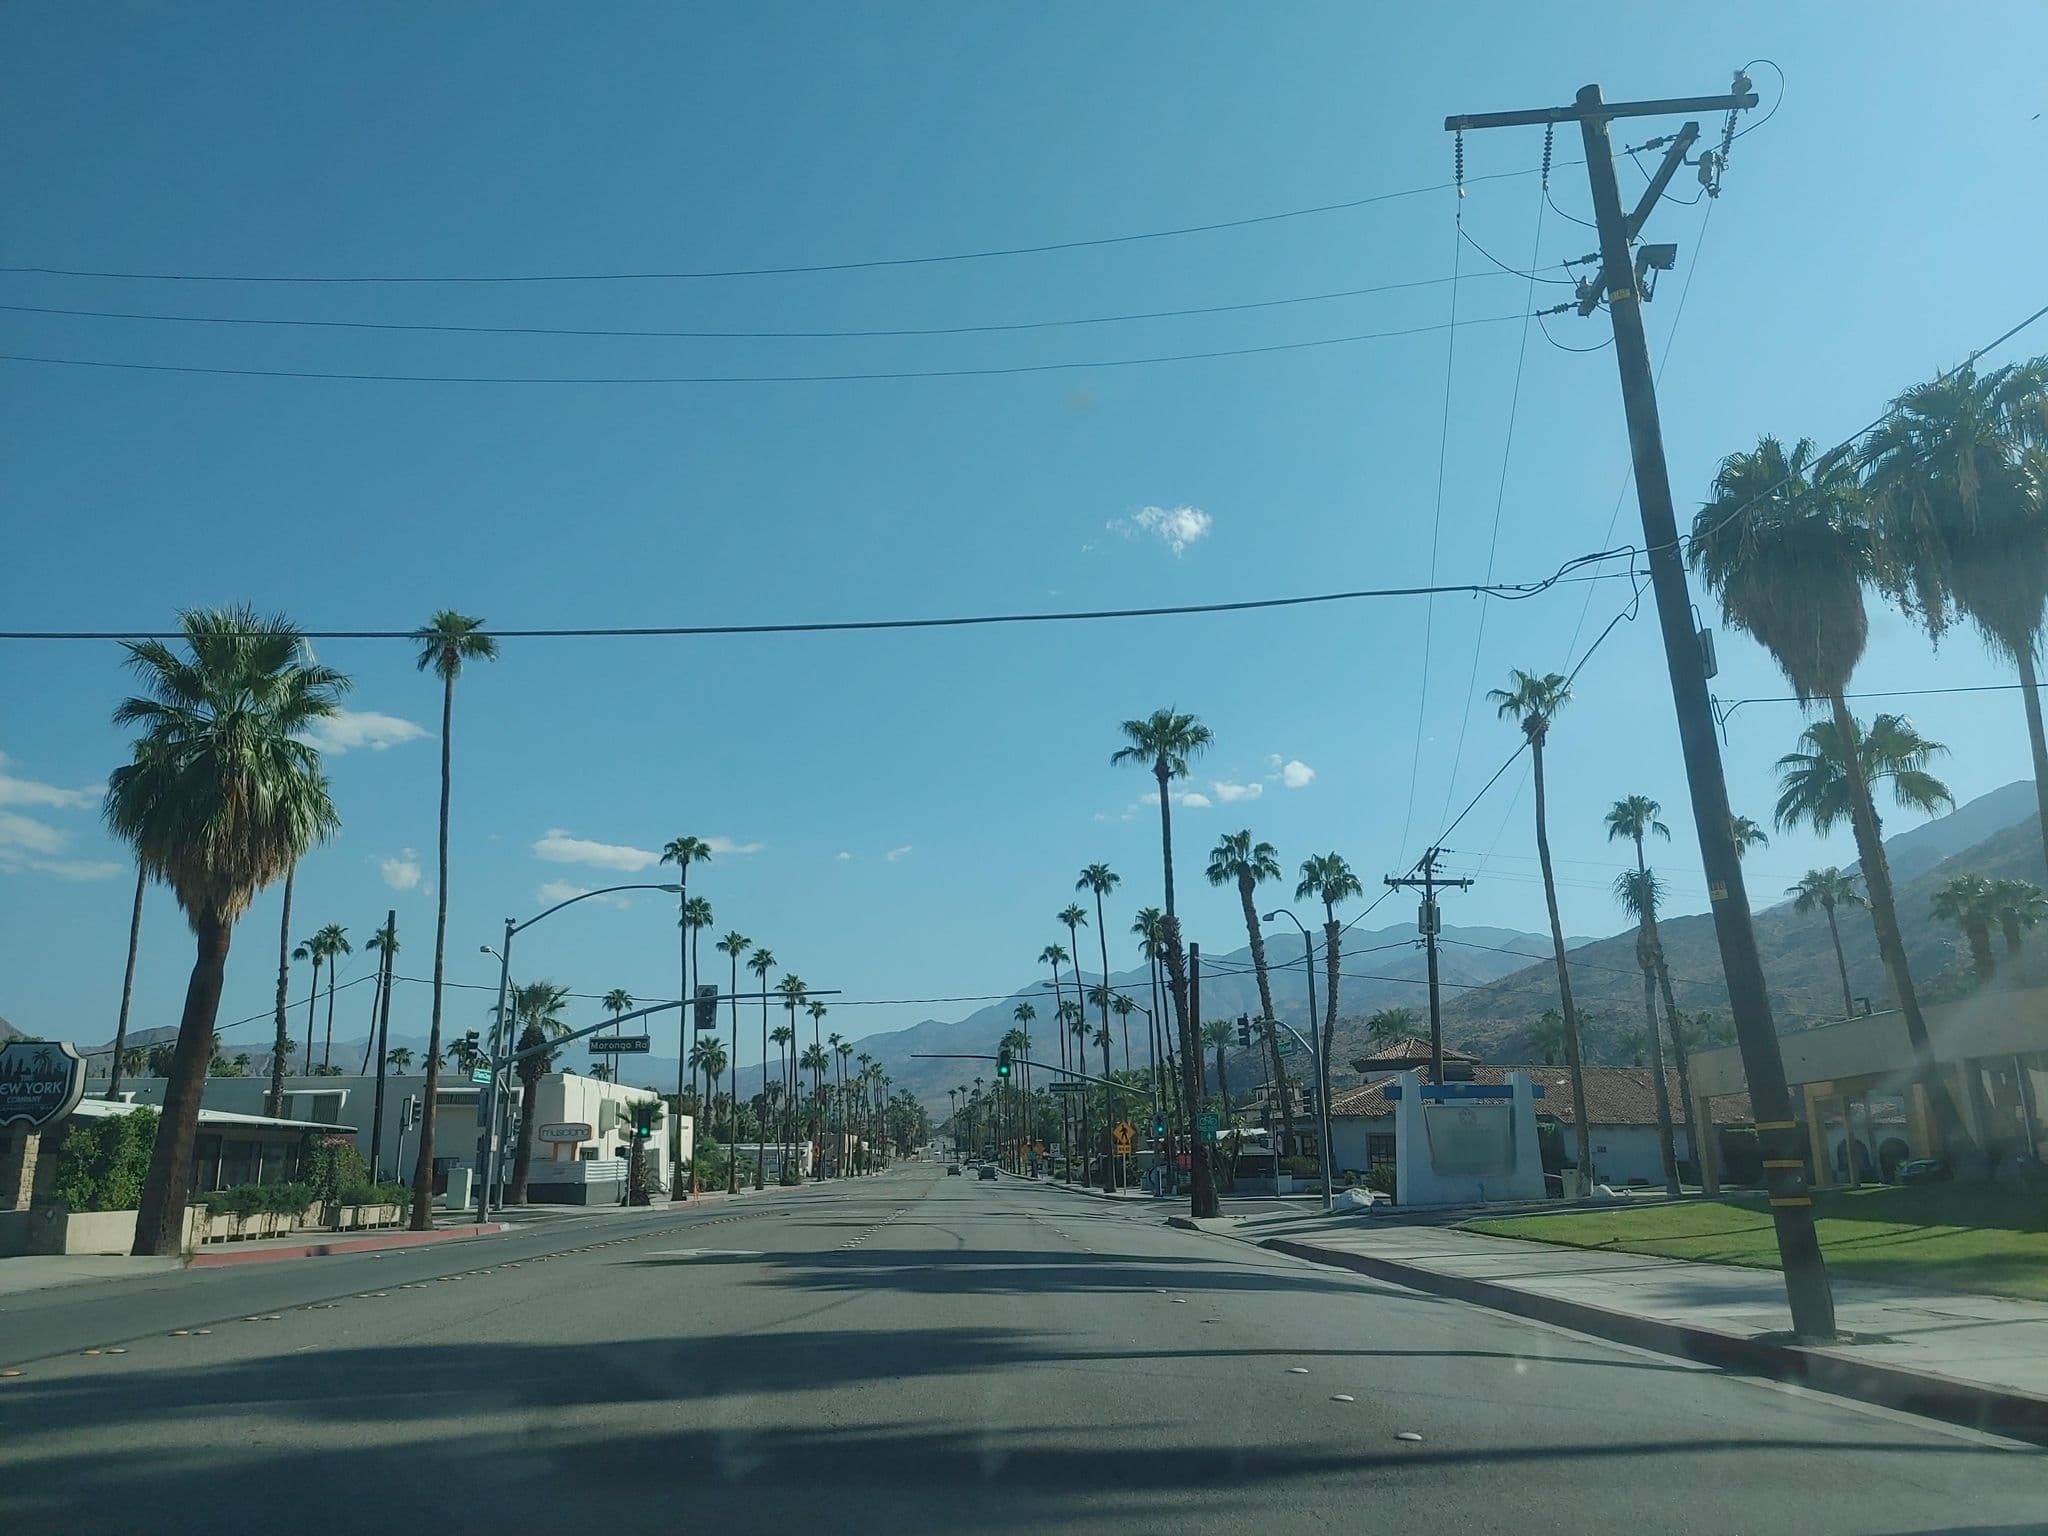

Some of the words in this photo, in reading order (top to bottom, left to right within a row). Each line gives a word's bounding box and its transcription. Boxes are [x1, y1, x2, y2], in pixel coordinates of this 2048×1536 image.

[591, 1041, 632, 1050] Morongo
[635, 1041, 647, 1049] Rd
[0, 1082, 22, 1095] EW
[25, 1081, 62, 1094] YORK
